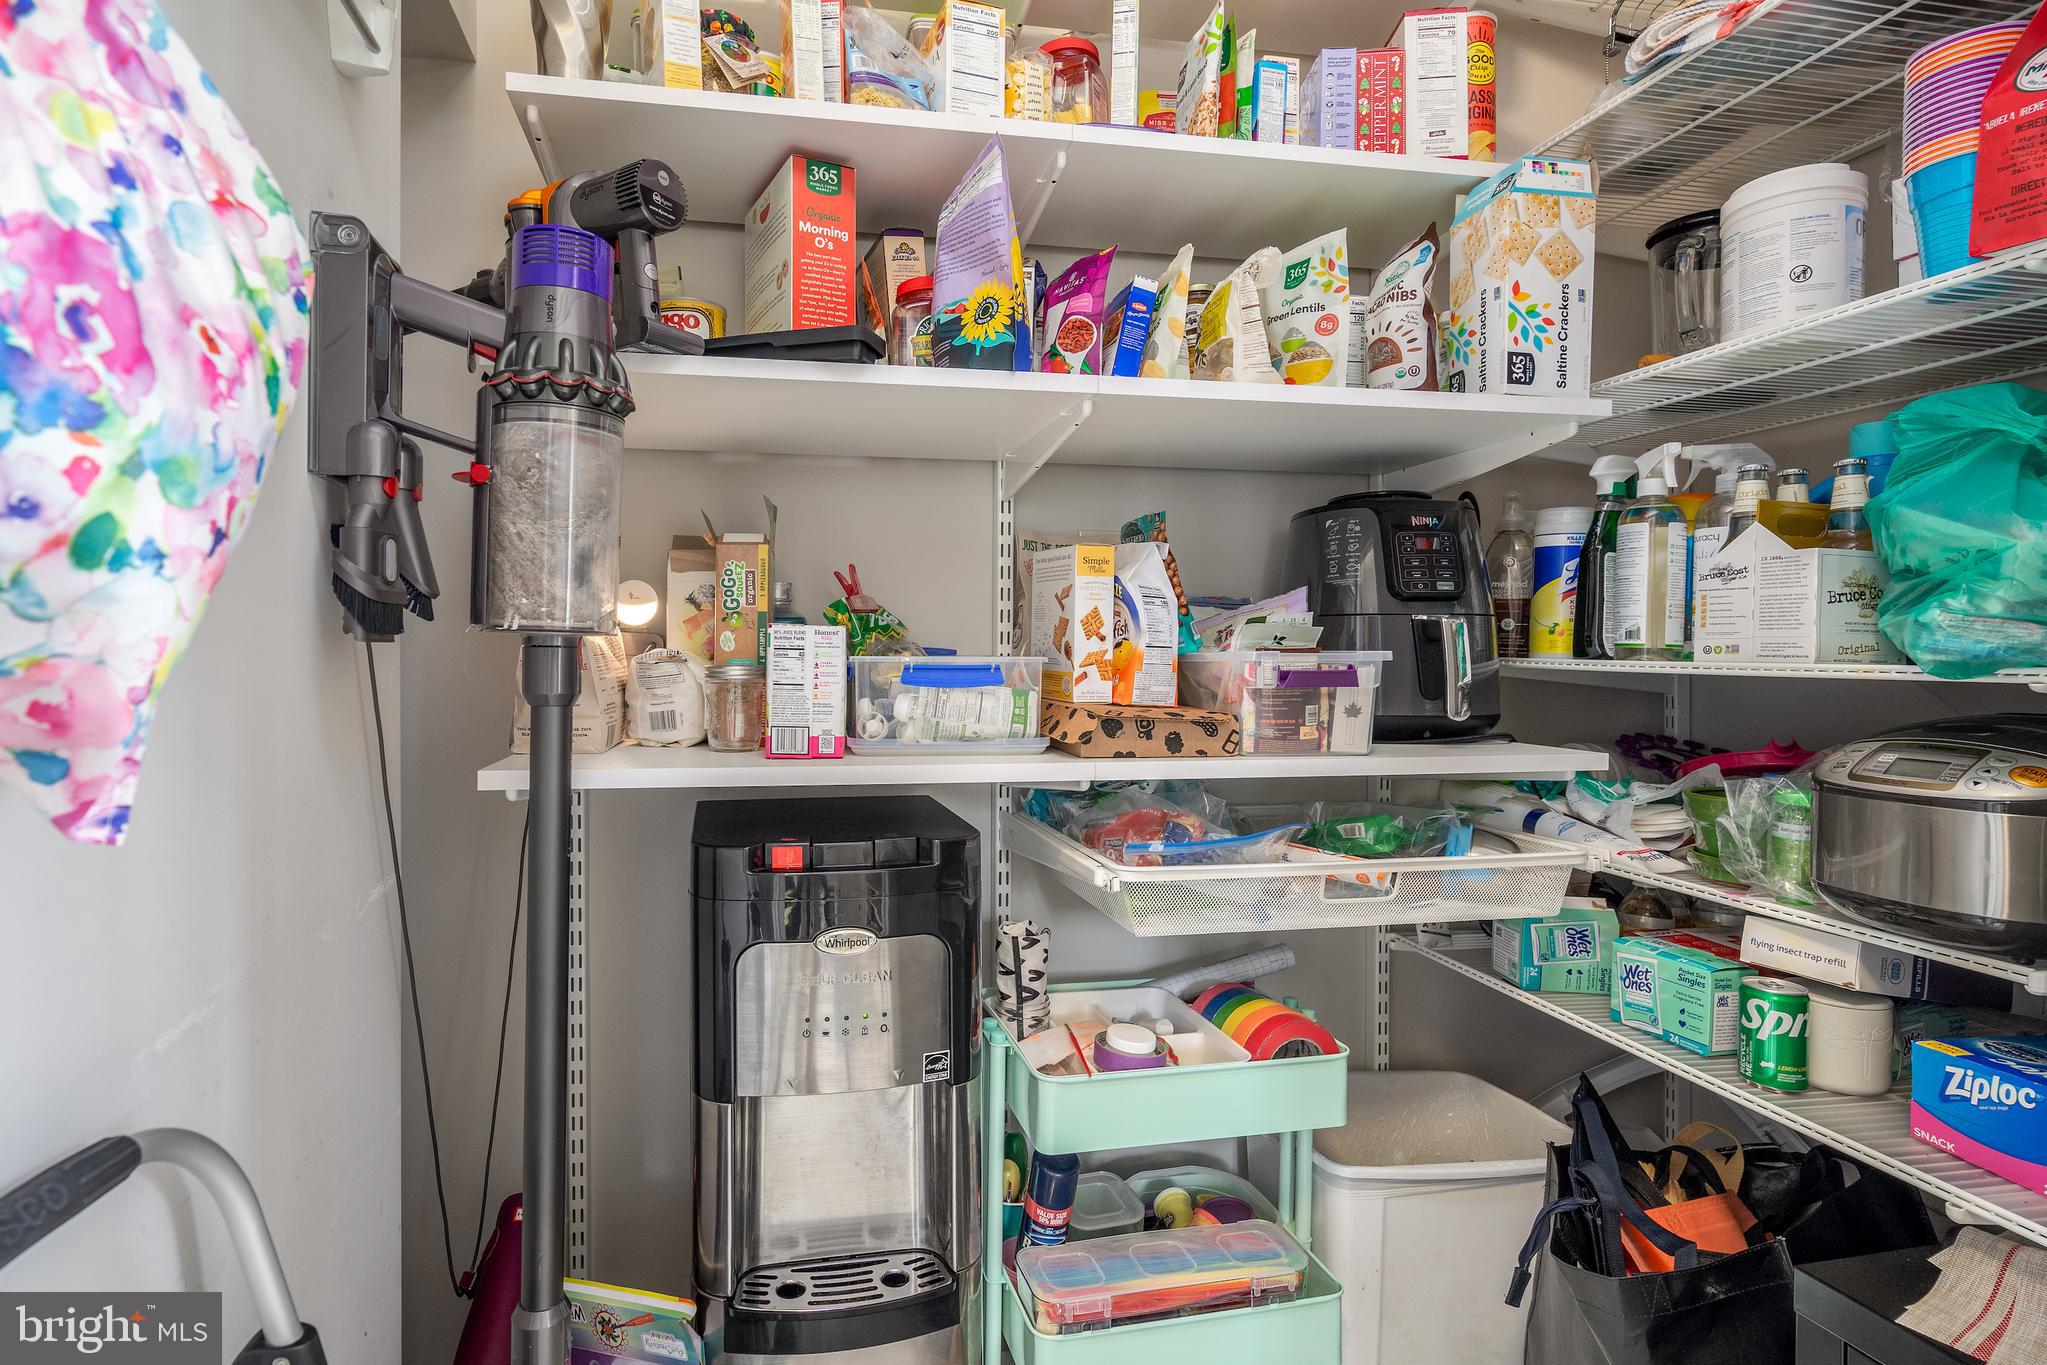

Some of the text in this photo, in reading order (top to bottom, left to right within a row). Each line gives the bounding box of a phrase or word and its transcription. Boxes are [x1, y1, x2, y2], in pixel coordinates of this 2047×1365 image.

[952, 4, 997, 18] Nutrition Facts
[952, 23, 999, 37] Calories 200
[1373, 58, 1387, 152] PEPPERMINT
[1148, 119, 1167, 127] MISS
[809, 165, 838, 185] 365
[579, 184, 604, 201] dyson
[805, 206, 841, 222] Organic
[799, 220, 849, 242] Morning
[815, 236, 834, 250] O's
[1287, 263, 1308, 282] 365
[1053, 275, 1087, 295] NAVITAS
[1281, 294, 1304, 308] Organic
[1386, 289, 1418, 303] NIBS
[546, 294, 557, 323] dyson
[1266, 302, 1326, 326] Green Lentils
[1320, 320, 1333, 330] 8g
[1478, 288, 1487, 393] Saltine Crackers
[1556, 283, 1570, 389] Saltine Crackers
[1511, 355, 1526, 382] 365
[1450, 375, 1460, 392] 65
[1738, 487, 1769, 498] Origin
[1410, 515, 1440, 528] NINJA
[1022, 539, 1038, 552] JUST
[1082, 555, 1110, 567] Simple
[1087, 565, 1105, 574] Mills
[734, 562, 744, 598] SQUEEZ
[1699, 565, 1750, 582] Bruce Cost
[720, 568, 741, 611] GoGo
[1827, 586, 1885, 605] Bruce Co
[1837, 642, 1881, 656] Original
[2019, 772, 2044, 785] REPEAT
[2022, 767, 2047, 780] START
[824, 936, 871, 950] Whirlpool
[1565, 926, 1579, 958] Ones
[1578, 927, 1592, 958] Wet
[1750, 937, 1848, 969] flying insect trap refill
[800, 969, 893, 986] SELF CLEAN
[1530, 967, 1538, 976] 24
[1599, 968, 1608, 992] Singles
[1623, 963, 1653, 982] Wet
[1678, 967, 1695, 977] Pocket
[1915, 957, 1924, 993] REFILLS
[1623, 976, 1653, 994] Ones
[1677, 973, 1706, 989] Singles
[1714, 982, 1733, 991] Singles
[1741, 998, 1809, 1041] Spr
[1669, 1033, 1680, 1044] 24
[1944, 1065, 2037, 1109] Ziploc
[1913, 1126, 1955, 1153] SNACK
[0, 1181, 69, 1246] SCO
[1036, 1207, 1068, 1219] VALUE SIZE
